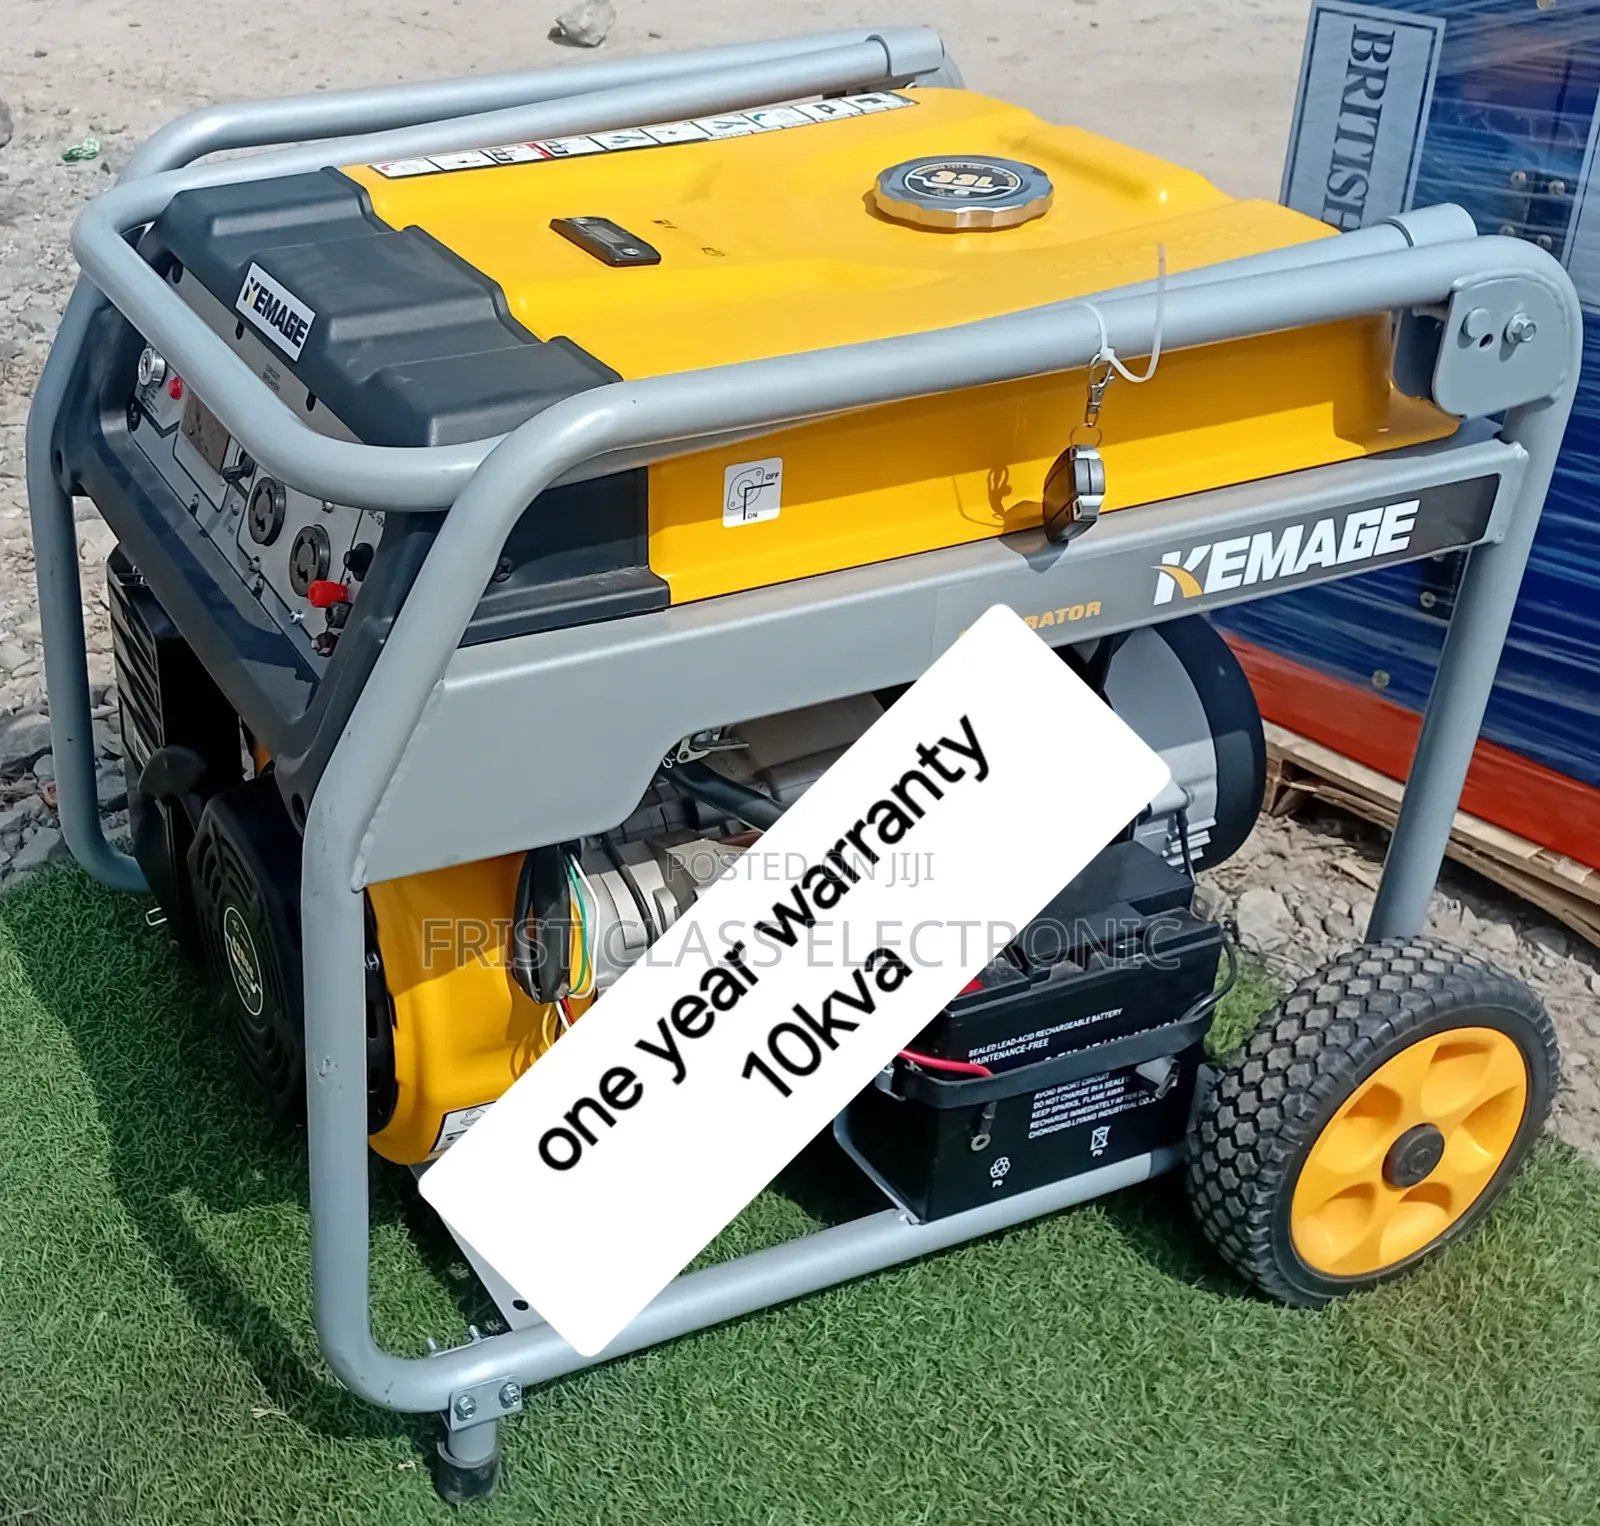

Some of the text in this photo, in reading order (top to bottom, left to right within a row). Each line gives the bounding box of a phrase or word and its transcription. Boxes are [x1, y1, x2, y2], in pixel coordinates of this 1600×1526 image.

[765, 471, 780, 480] OFF
[1150, 499, 1421, 606] KEMAGE
[968, 1044, 997, 1058] SEALED
[1035, 1016, 1091, 1038] RECHARGEABLE
[1091, 1008, 1124, 1023] BATTERY
[1033, 1100, 1044, 1110] DO
[1045, 1096, 1060, 1106] NOT
